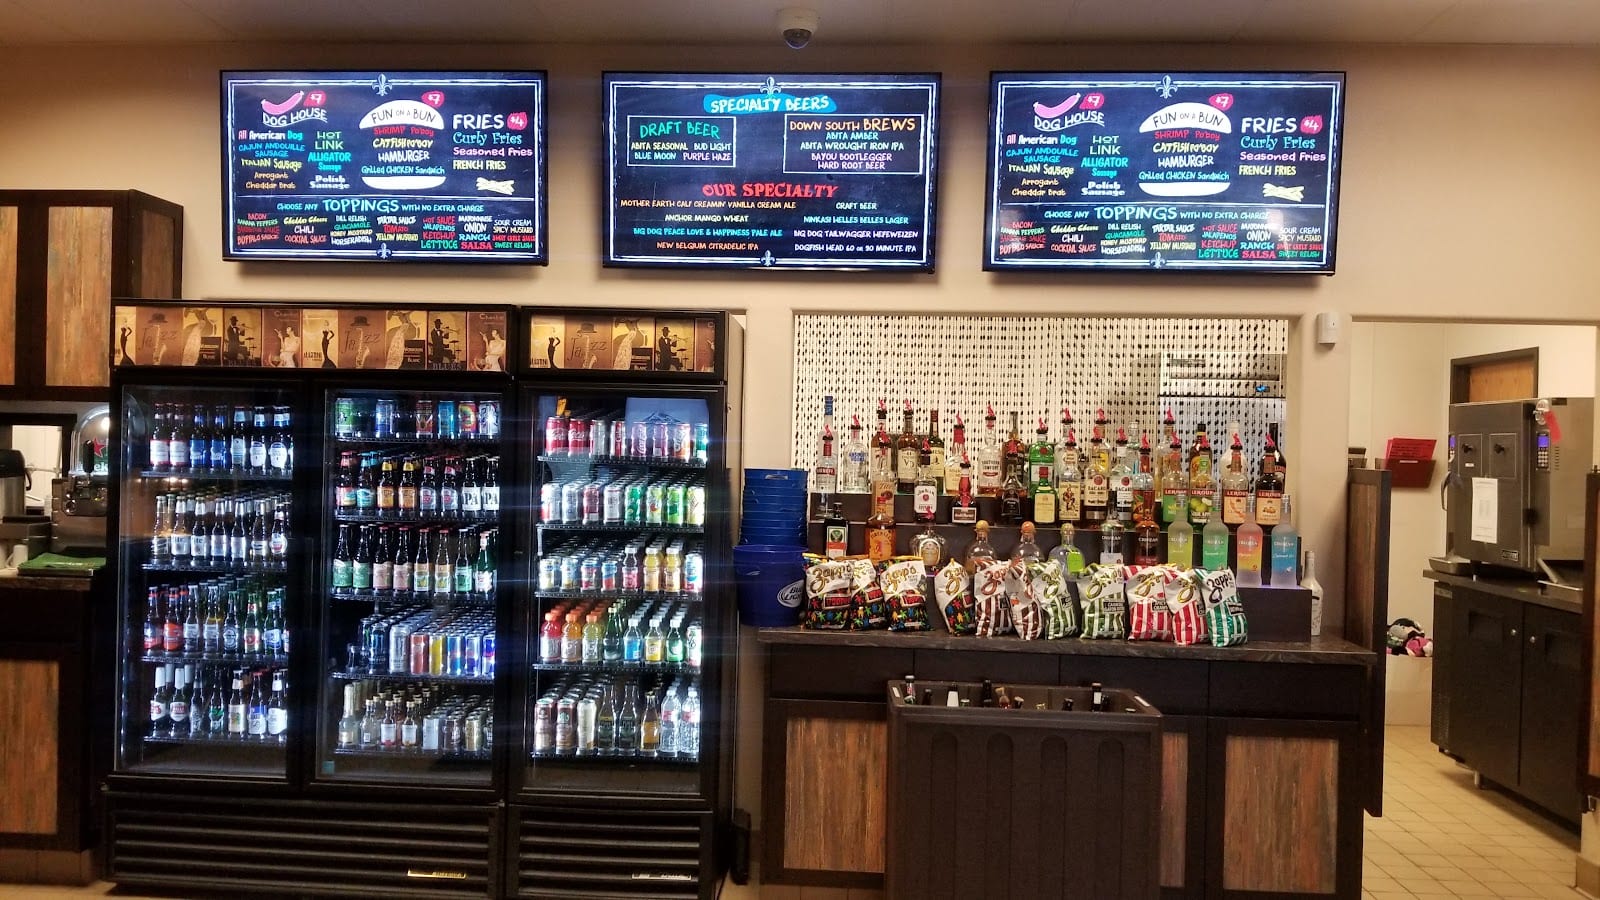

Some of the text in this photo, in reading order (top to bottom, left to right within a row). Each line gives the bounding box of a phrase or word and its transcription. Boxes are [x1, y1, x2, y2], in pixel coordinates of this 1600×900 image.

[428, 94, 440, 104] $7
[711, 96, 829, 113] SPECIALTY BEERS
[1215, 96, 1230, 108] $7
[263, 108, 327, 126] DOG HOUSE
[372, 109, 392, 124] FUN
[414, 108, 436, 123] BUN
[1034, 111, 1104, 130] DOG HOUSE
[1153, 112, 1177, 128] FUN
[1199, 112, 1224, 126] BUN
[453, 114, 524, 130] FRIES $4
[790, 118, 915, 131] DOWN SOUTH BREWS
[1241, 118, 1318, 133] FRIES $4
[238, 130, 303, 141] All American Dog
[317, 131, 342, 139] HOT
[374, 126, 406, 135] SHRIMP
[640, 121, 720, 139] DRAFT BEER
[373, 138, 406, 148] CATFISH
[453, 132, 522, 146] Curly Fries
[1006, 134, 1077, 145] All American Dog
[1092, 135, 1119, 144] HOT
[1241, 136, 1316, 150] Curly Fries
[239, 143, 305, 152] CAJUN ANDOUILLE
[315, 141, 344, 150] LINK
[631, 142, 650, 150] ABITA
[653, 142, 688, 150] SEASONAL
[800, 142, 822, 150] ABITA
[825, 142, 867, 150] WROUGHT
[891, 142, 904, 150] IPA
[1090, 146, 1121, 155] LINK
[308, 152, 351, 162] ALLIGATOR
[378, 150, 430, 162] HAMBURGER
[453, 147, 504, 156] Seasoned
[840, 153, 892, 161] BOOTLEGGER
[1240, 152, 1296, 162] Seasoned
[241, 159, 302, 172] ITALIAN Sausage
[453, 160, 506, 170] FRENCH FRIES
[1081, 157, 1128, 167] ALLIGATOR
[1158, 156, 1214, 168] HAMBURGER
[386, 166, 414, 174] CHICKEN
[415, 166, 445, 175] Sandwich
[1239, 165, 1297, 176] FRENCH FRIES
[310, 181, 350, 189] Sausage
[702, 183, 838, 198] OUR SPECIALTY
[322, 199, 399, 213] TOPPINGS
[1094, 206, 1177, 220] TOPPINGS
[464, 223, 486, 232] ONION
[423, 232, 455, 240] KETCHUP
[421, 240, 458, 249] LETTUCE
[567, 336, 608, 362] Jazz
